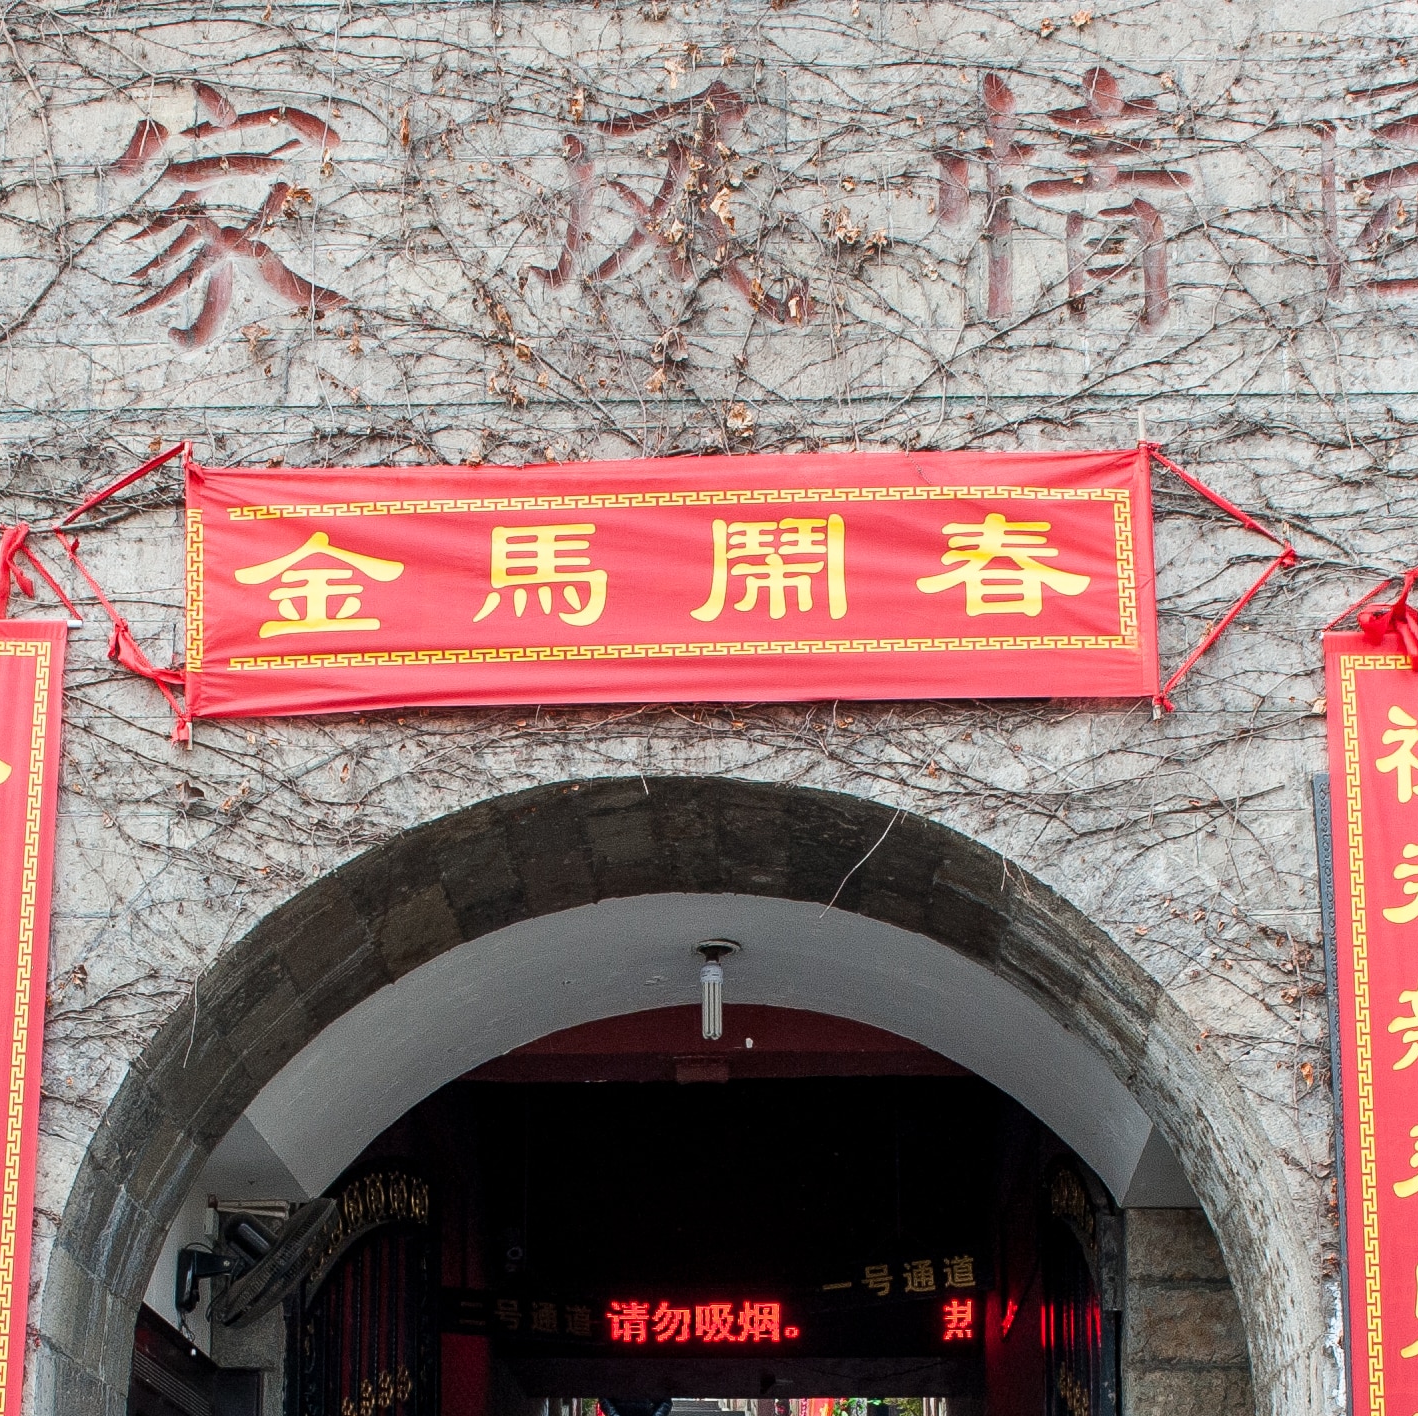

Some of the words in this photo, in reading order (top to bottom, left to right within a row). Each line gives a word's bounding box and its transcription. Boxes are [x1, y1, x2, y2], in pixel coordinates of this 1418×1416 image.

[233, 512, 1090, 639] 金馬鬧春
[821, 1255, 977, 1298] 一号通道
[458, 1300, 593, 1338] 二号通道
